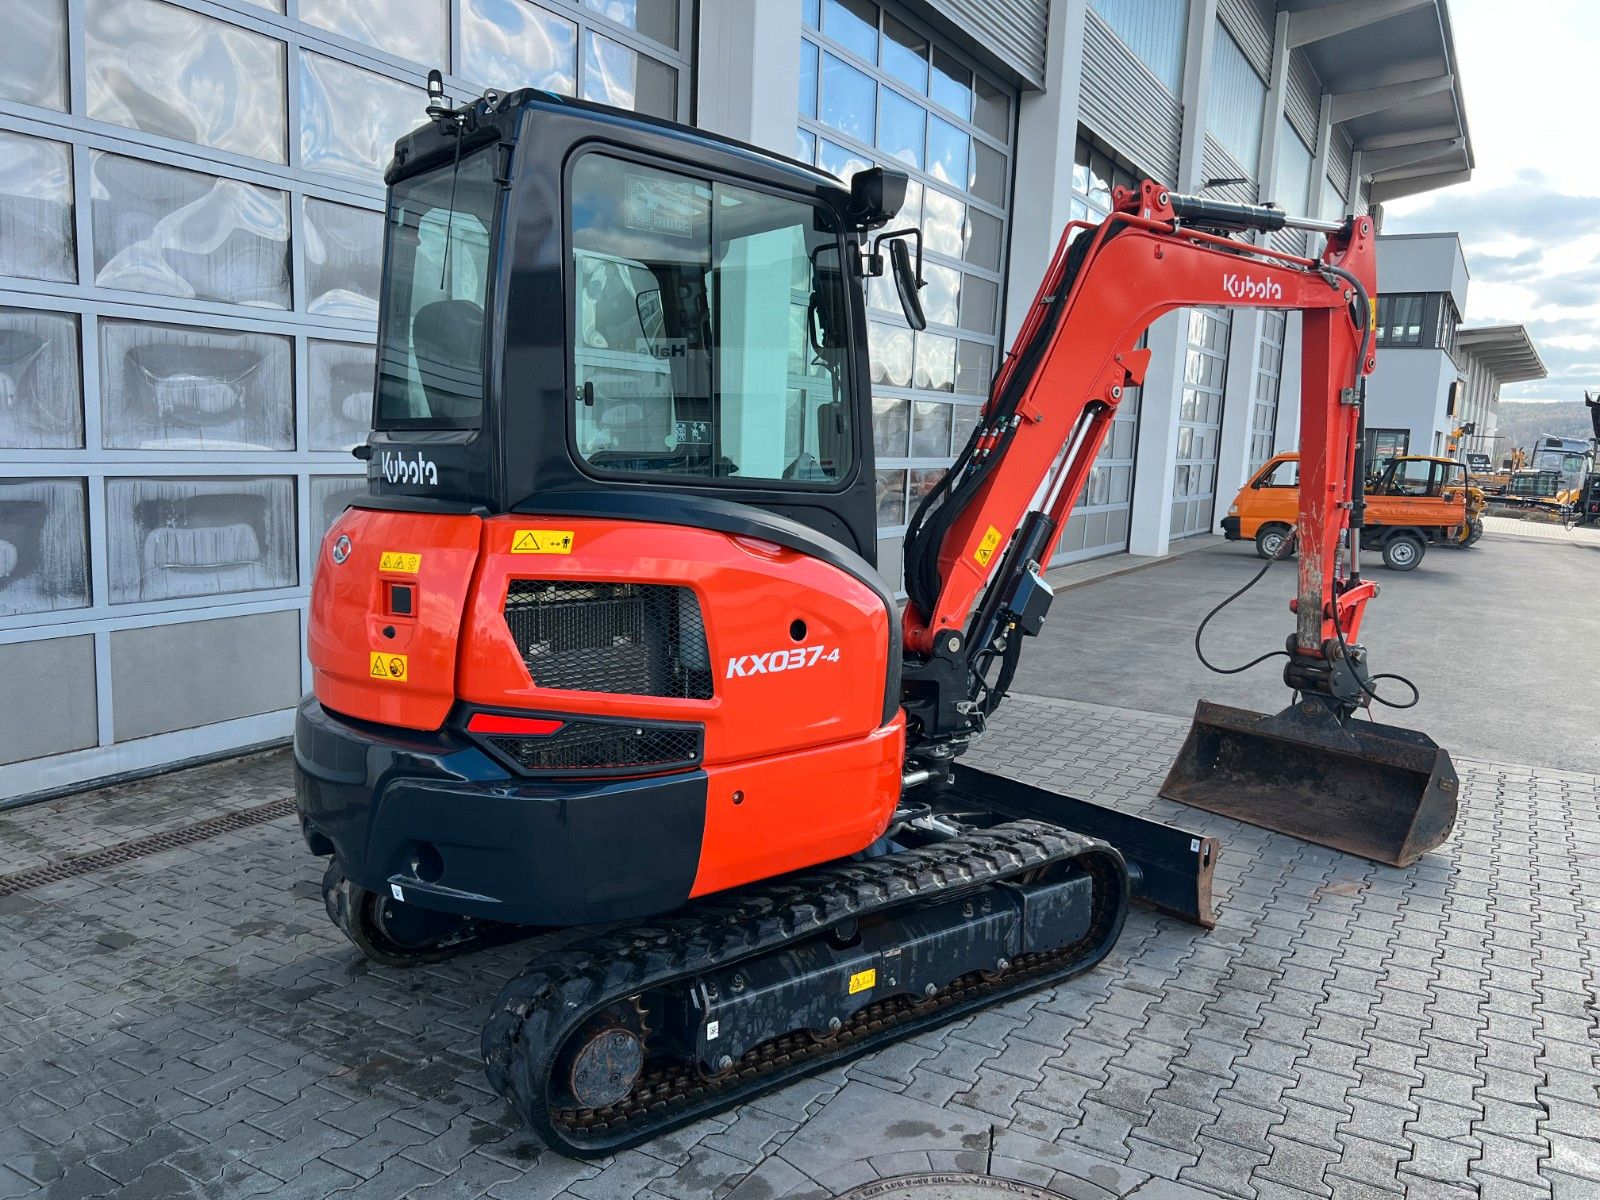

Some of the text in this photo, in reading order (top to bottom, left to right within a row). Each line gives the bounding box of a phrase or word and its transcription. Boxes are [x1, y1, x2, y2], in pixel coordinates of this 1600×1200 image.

[1223, 273, 1282, 300] Kubota
[381, 451, 438, 485] Kubota
[726, 645, 840, 679] KX037-4
